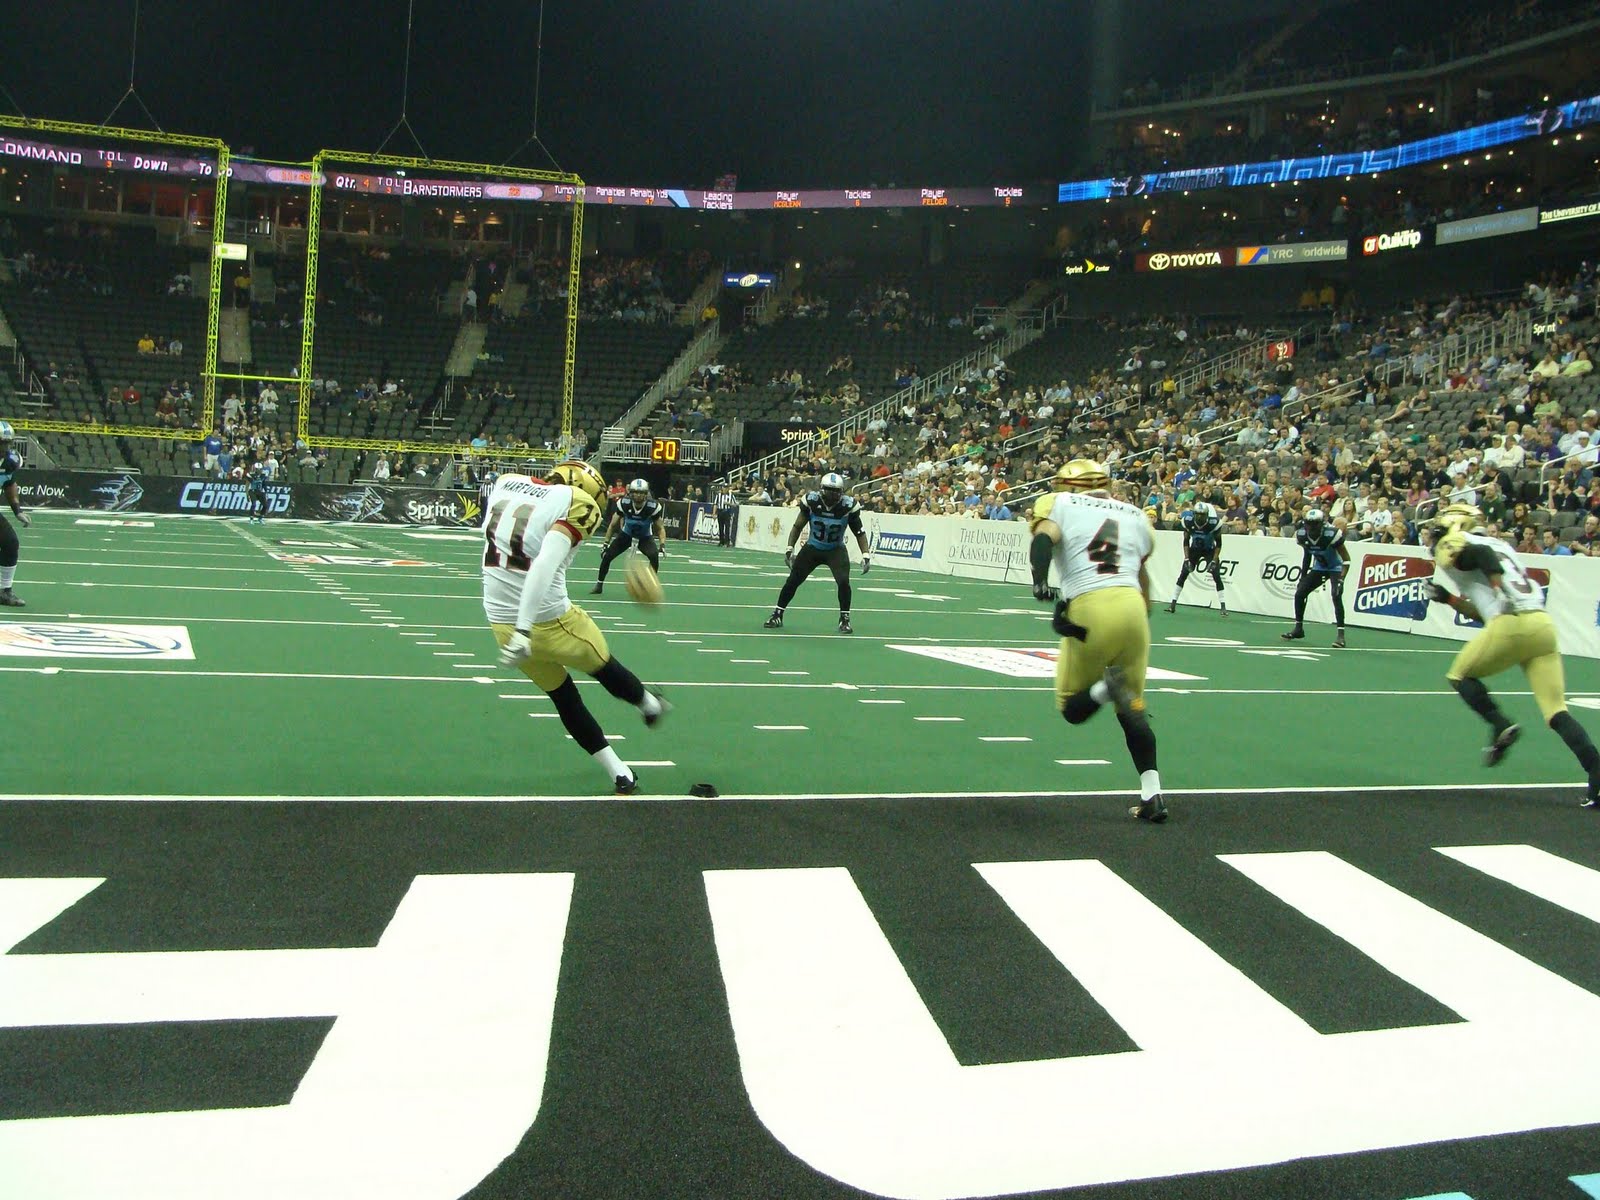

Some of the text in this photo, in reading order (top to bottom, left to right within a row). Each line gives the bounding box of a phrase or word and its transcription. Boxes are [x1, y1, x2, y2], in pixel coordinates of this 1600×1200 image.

[133, 156, 168, 171] Down
[199, 162, 212, 175] To
[335, 175, 356, 189] Qtr.
[403, 180, 482, 198] BARNSTORMERS
[703, 191, 733, 202] Leading
[776, 191, 799, 202] Player
[845, 190, 871, 199] Tackles
[921, 189, 945, 200] Player
[994, 187, 1023, 197] Tackles
[702, 200, 733, 210] Tacklers
[922, 197, 948, 206] FELDER
[1171, 252, 1222, 267] TOYOTA
[1272, 249, 1293, 259] YRC
[1065, 265, 1083, 275] Sprint
[1533, 322, 1556, 336] Sprnt
[781, 428, 814, 443] Sprint
[653, 440, 676, 461] 20
[409, 500, 457, 519] Sprint
[484, 499, 536, 572] 11
[813, 520, 842, 544] 32
[960, 527, 1023, 548] THE UNIVERSITY
[880, 536, 923, 552] MICHELIN
[1087, 518, 1121, 575] 4
[960, 545, 990, 562] KANSAS
[1261, 562, 1301, 582] BOO
[1364, 558, 1407, 585] PRICE
[1357, 578, 1427, 611] CHOPPER
